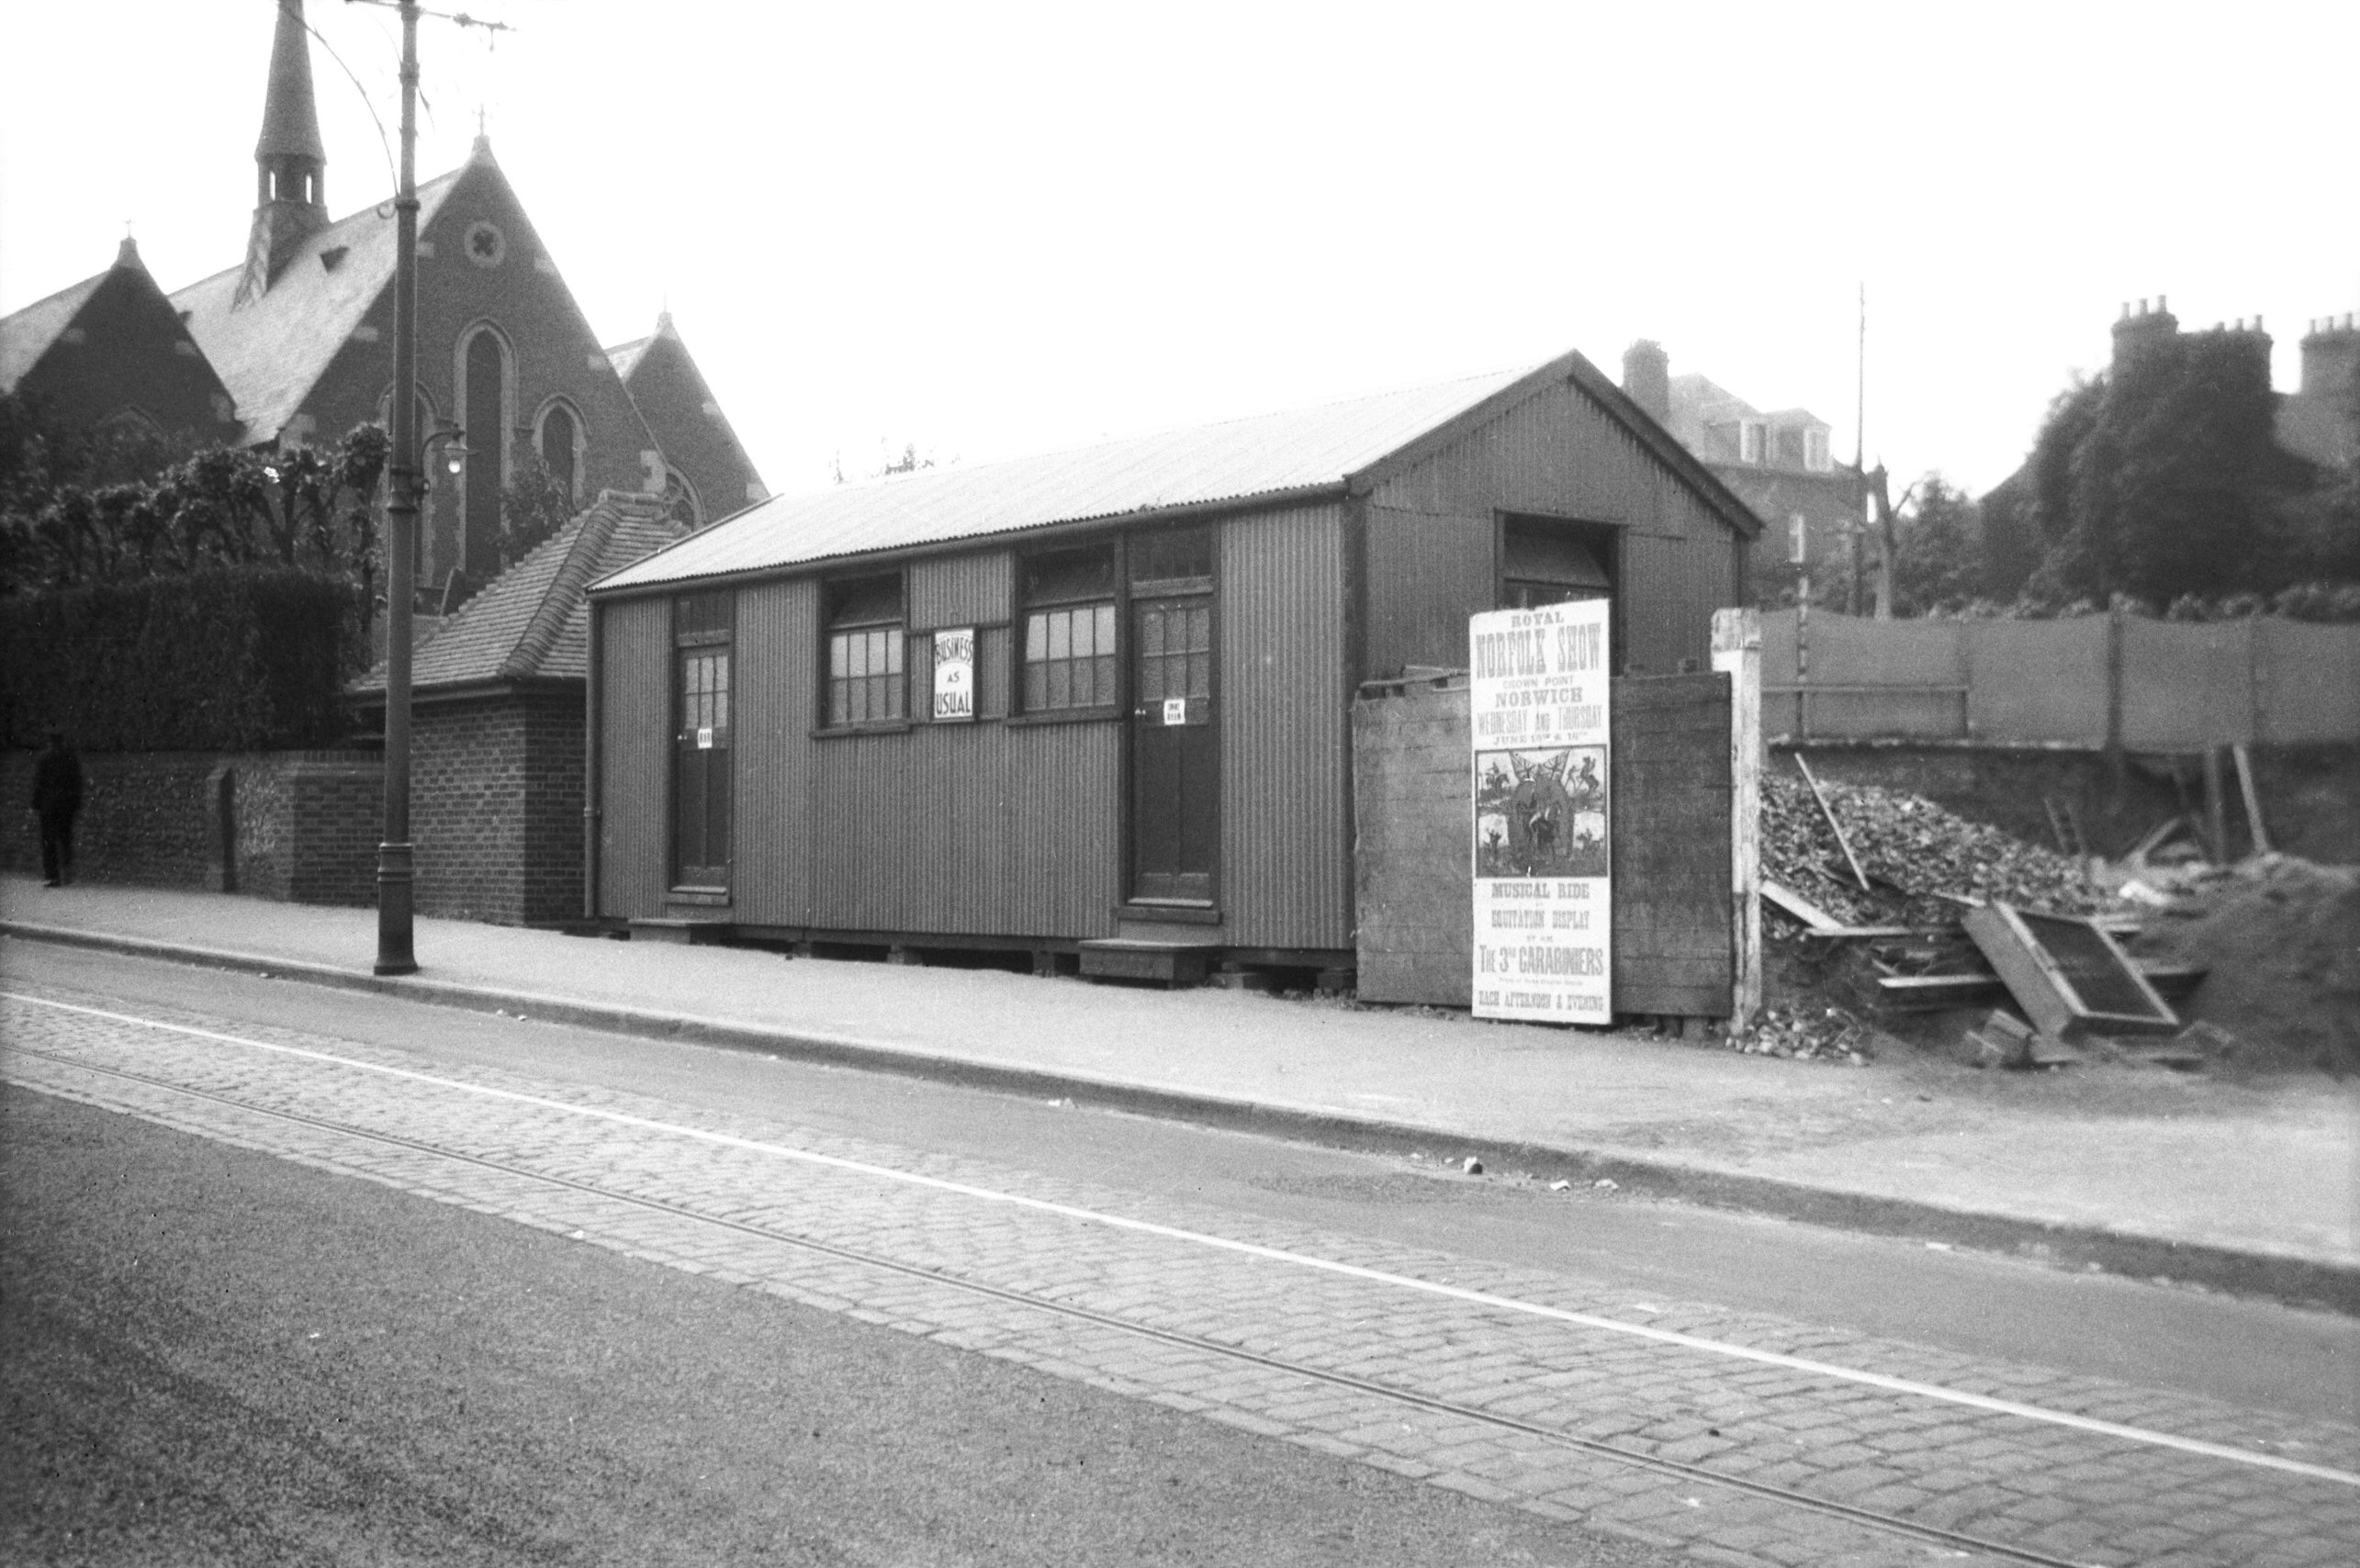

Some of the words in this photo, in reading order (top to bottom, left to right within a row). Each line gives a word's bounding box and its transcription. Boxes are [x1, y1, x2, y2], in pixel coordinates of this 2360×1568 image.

[1511, 611, 1565, 628] ROYAL
[936, 636, 972, 666] BUSINESS
[1476, 628, 1546, 679] NORFOLK
[1557, 622, 1601, 673] SHOW
[947, 671, 961, 683] AS
[1502, 678, 1538, 689] CROWN
[1545, 676, 1574, 688] POINT
[936, 691, 971, 714] USUAL
[1495, 687, 1583, 708] NORWICH
[1477, 710, 1527, 735] WEDNESDAY
[1558, 705, 1602, 731] THURSDAY
[1493, 734, 1527, 745] JUNE
[1491, 882, 1550, 899] MUSICAL
[1557, 883, 1590, 899] RIDE
[1491, 910, 1545, 930] EQUITATION
[1552, 910, 1590, 930] DISPLAY
[1479, 945, 1496, 973] THE
[1519, 946, 1603, 976] CARABINIERS
[1478, 991, 1500, 1007] EACH
[1504, 991, 1551, 1009] AFTERNOON
[1567, 994, 1603, 1011] EVENING
